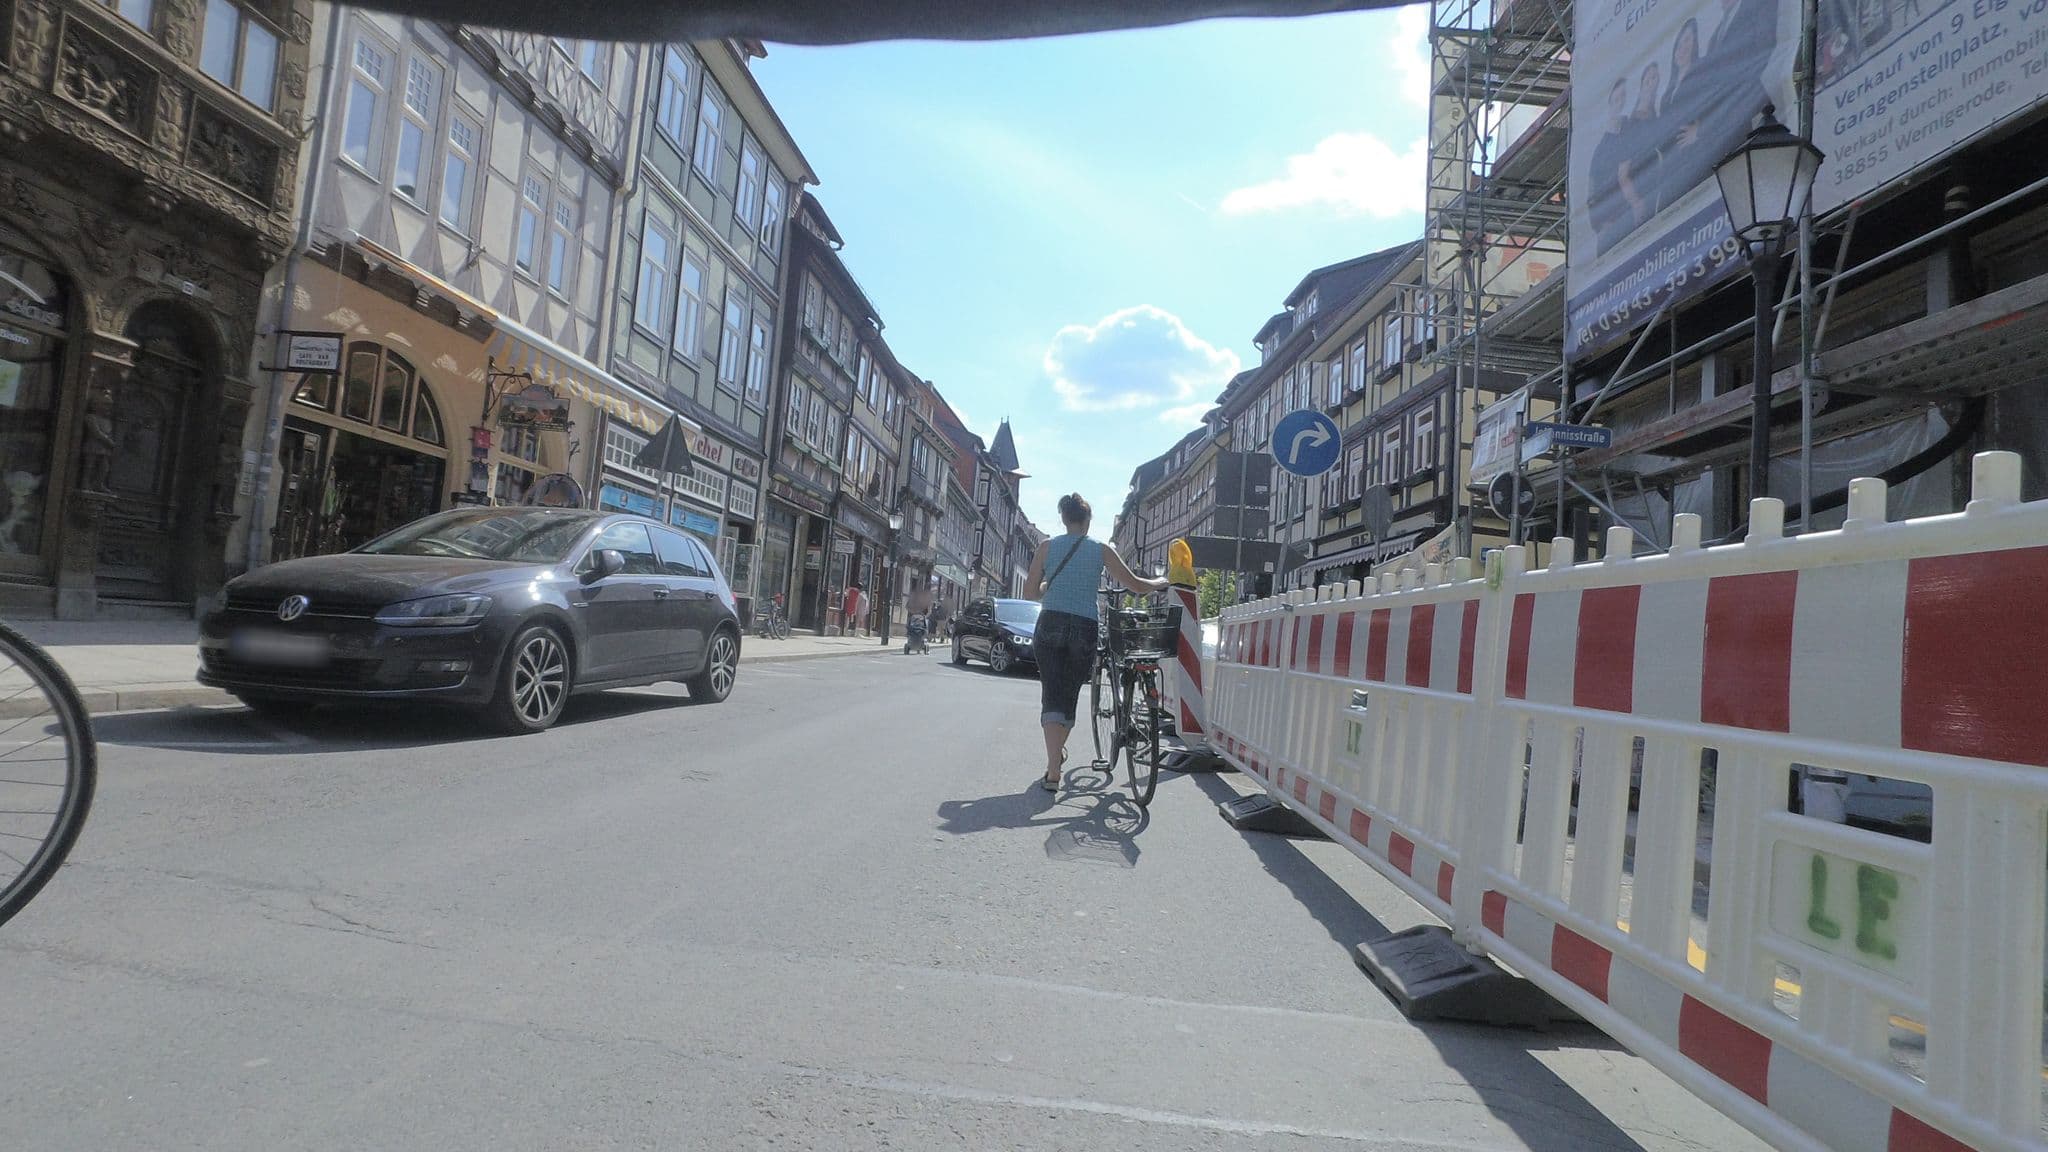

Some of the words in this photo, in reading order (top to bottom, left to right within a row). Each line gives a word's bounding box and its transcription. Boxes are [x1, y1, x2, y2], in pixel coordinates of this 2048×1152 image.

[1834, 52, 1904, 110] Verkauf
[1909, 31, 1943, 62] von
[1951, 12, 1964, 35] 9
[1834, 22, 2009, 136] Garagenstellplatz,
[1834, 117, 1894, 163] Verkauf
[1900, 85, 1953, 127] durch:
[1961, 25, 2048, 89] Immobili
[1834, 145, 1889, 186] 38855
[1895, 80, 2014, 151] Wernigerode,
[1575, 212, 1731, 321] www.immobilien-imp
[1577, 322, 1599, 346] Tel.
[1535, 426, 1606, 444] Jonnisstraße
